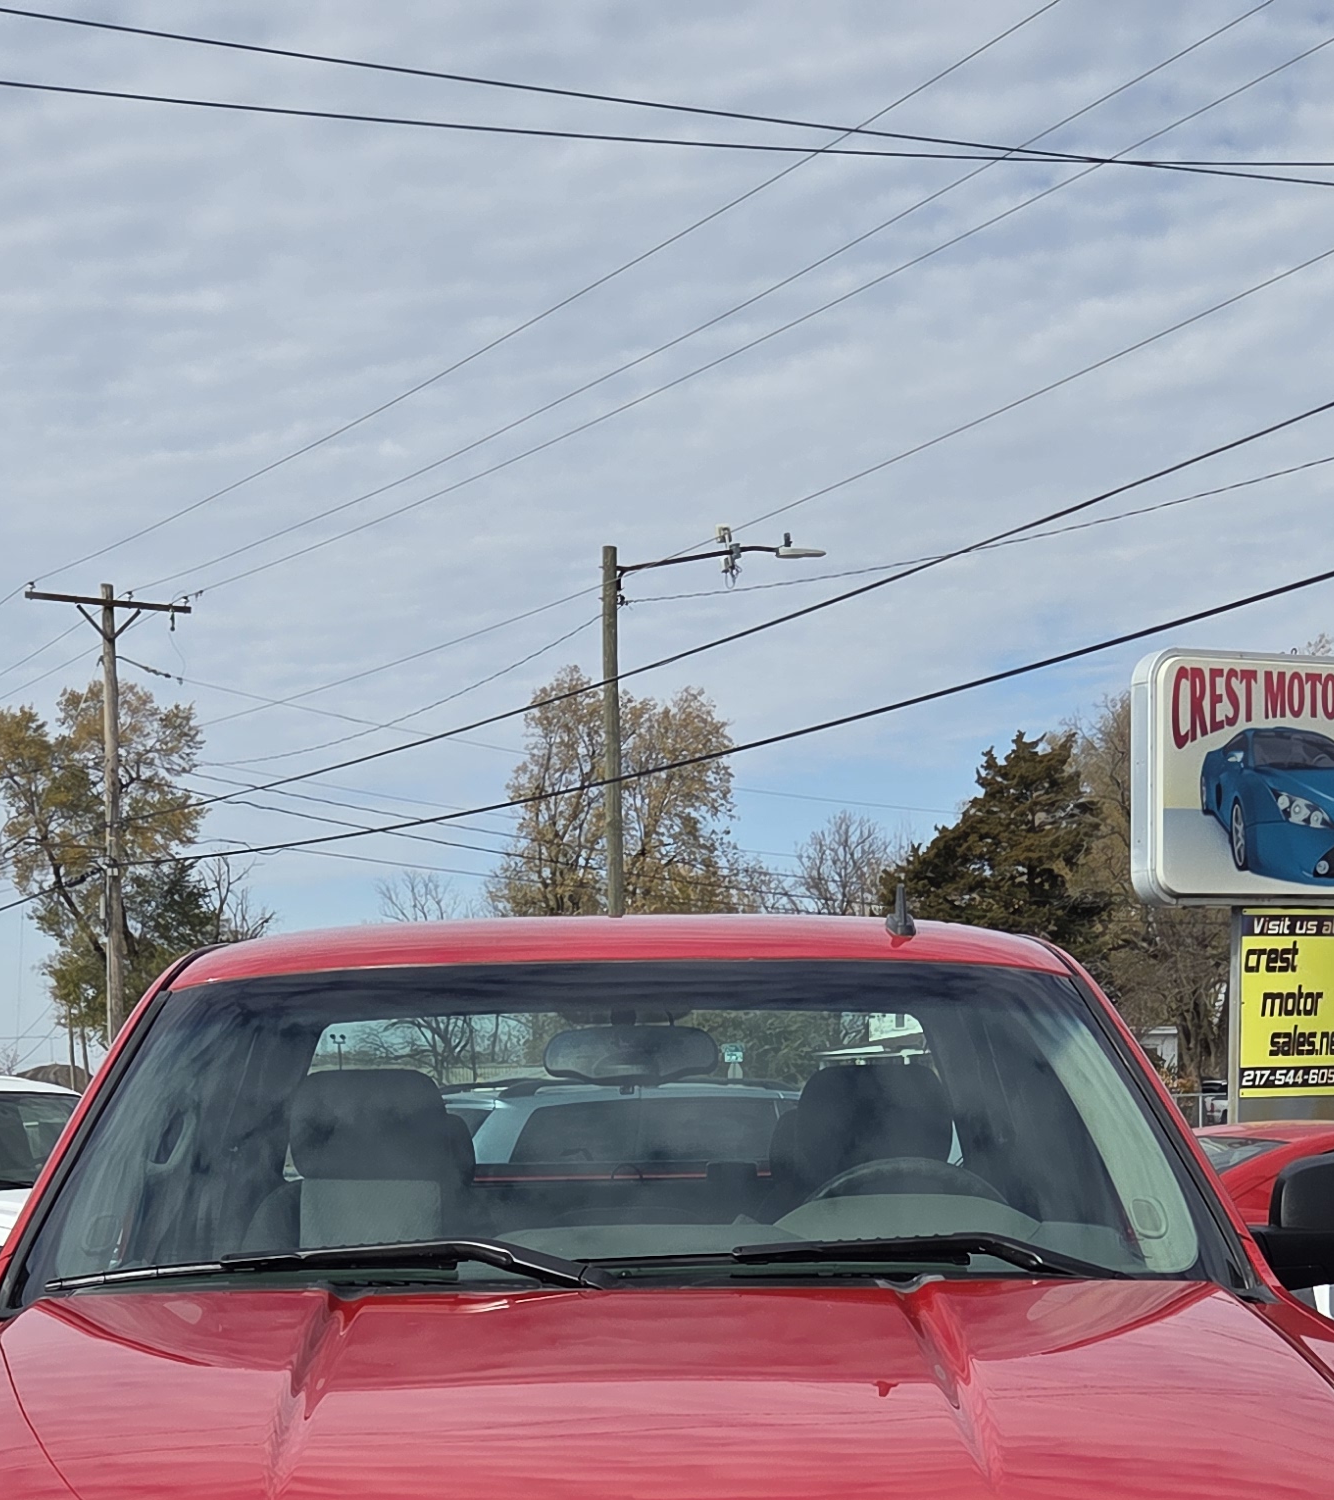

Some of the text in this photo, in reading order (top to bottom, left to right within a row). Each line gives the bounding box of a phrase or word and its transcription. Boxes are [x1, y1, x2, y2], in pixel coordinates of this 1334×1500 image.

[1171, 665, 1258, 750] CREST
[1253, 917, 1291, 934] Visit
[1295, 920, 1318, 934] us
[1244, 940, 1299, 973] crest
[1260, 984, 1324, 1018] motor
